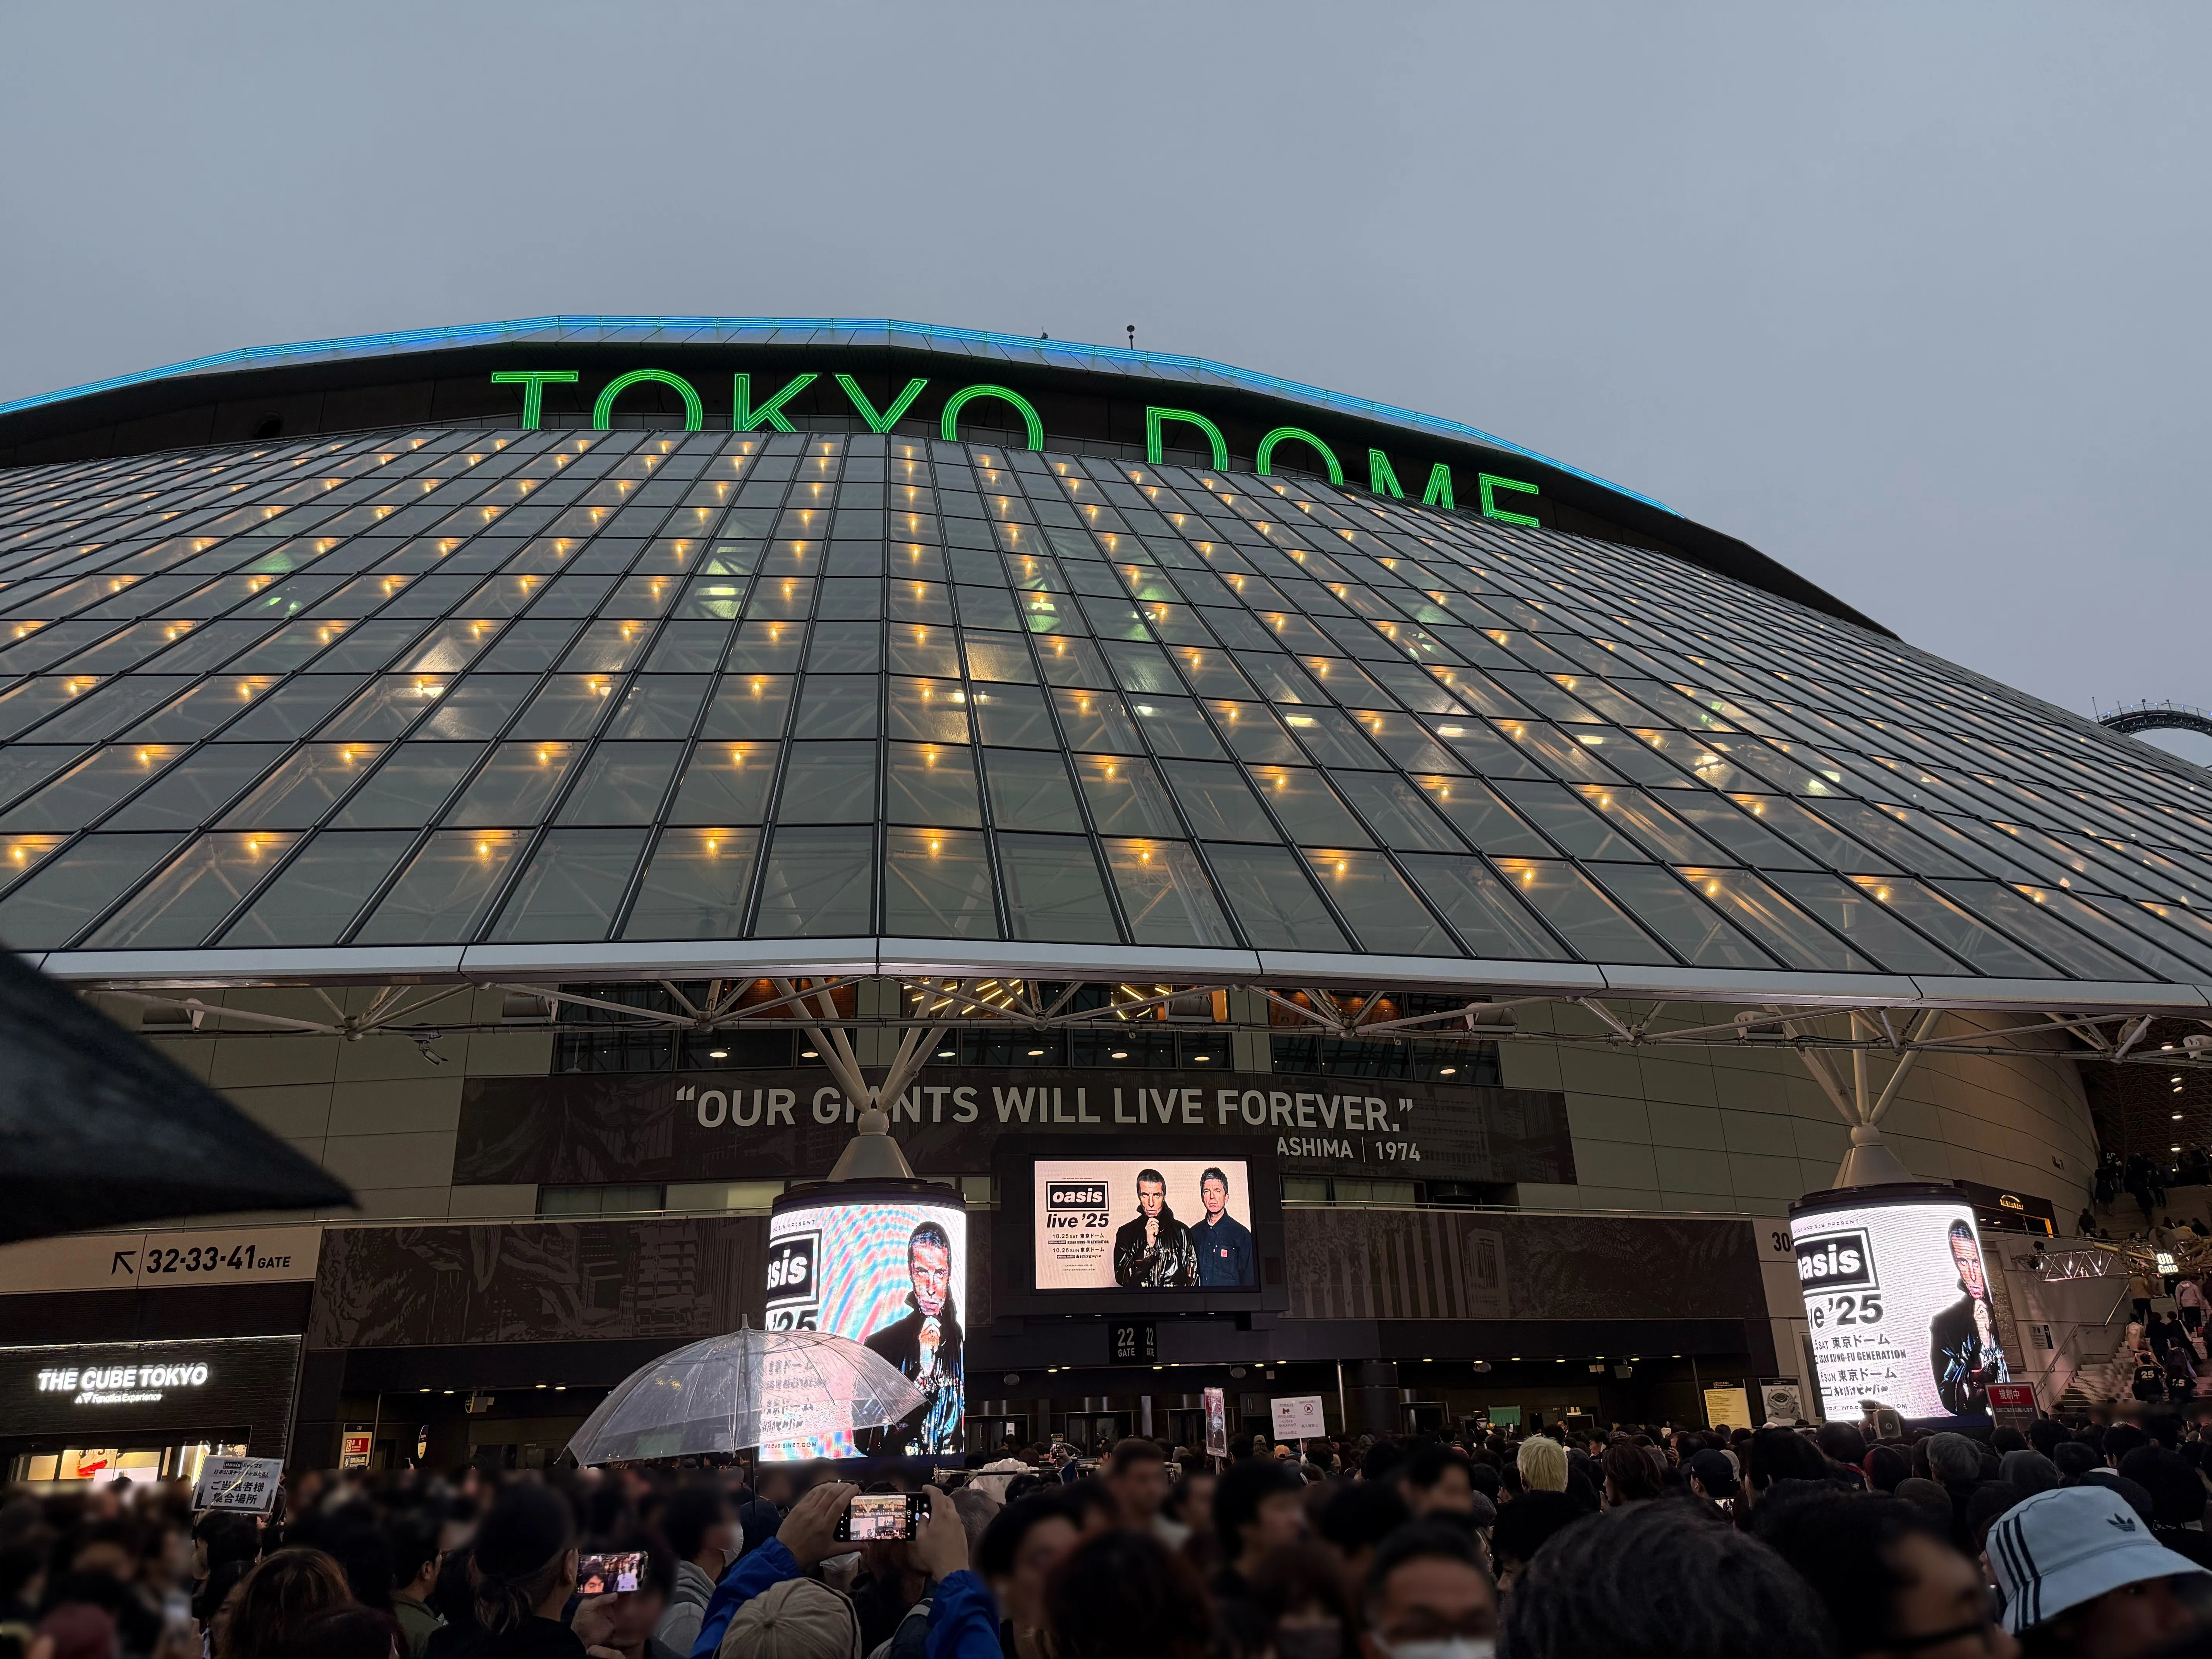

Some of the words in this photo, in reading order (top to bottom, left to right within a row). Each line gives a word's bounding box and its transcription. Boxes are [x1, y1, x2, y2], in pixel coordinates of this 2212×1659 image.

[491, 369, 1044, 451] TOKYO
[1146, 405, 1540, 528] DOME
[996, 1086, 1100, 1123] WILL
[1114, 1088, 1203, 1124] LIVE
[1376, 1141, 1421, 1161] 1974
[1053, 1188, 1103, 1203] oasis
[1047, 1214, 1078, 1228] live
[258, 1256, 291, 1268] GATE
[2157, 1253, 2174, 1264] Oh
[767, 1249, 807, 1290] sis
[2158, 1265, 2179, 1274] Gate
[1118, 1328, 1134, 1346] 22
[1146, 1327, 1154, 1346] 22
[1831, 1333, 1890, 1349] 東京ドーム
[1118, 1348, 1135, 1357] GATE
[1830, 1352, 1855, 1362] KUNG-FU
[1856, 1349, 1906, 1360] GENERATION
[38, 1371, 78, 1391] THE
[81, 1368, 137, 1389] CUBE
[139, 1365, 208, 1387] TOKYO
[1824, 1373, 1836, 1382] SUN
[1838, 1367, 1897, 1382] 東京ドーム
[2141, 1370, 2154, 1379] 25
[93, 1394, 122, 1403] Fanatics
[122, 1393, 162, 1404] Experience
[1999, 1389, 2020, 1399] 規制中
[211, 1480, 264, 1492] ご当選者様
[212, 1492, 258, 1504] 集合場所
